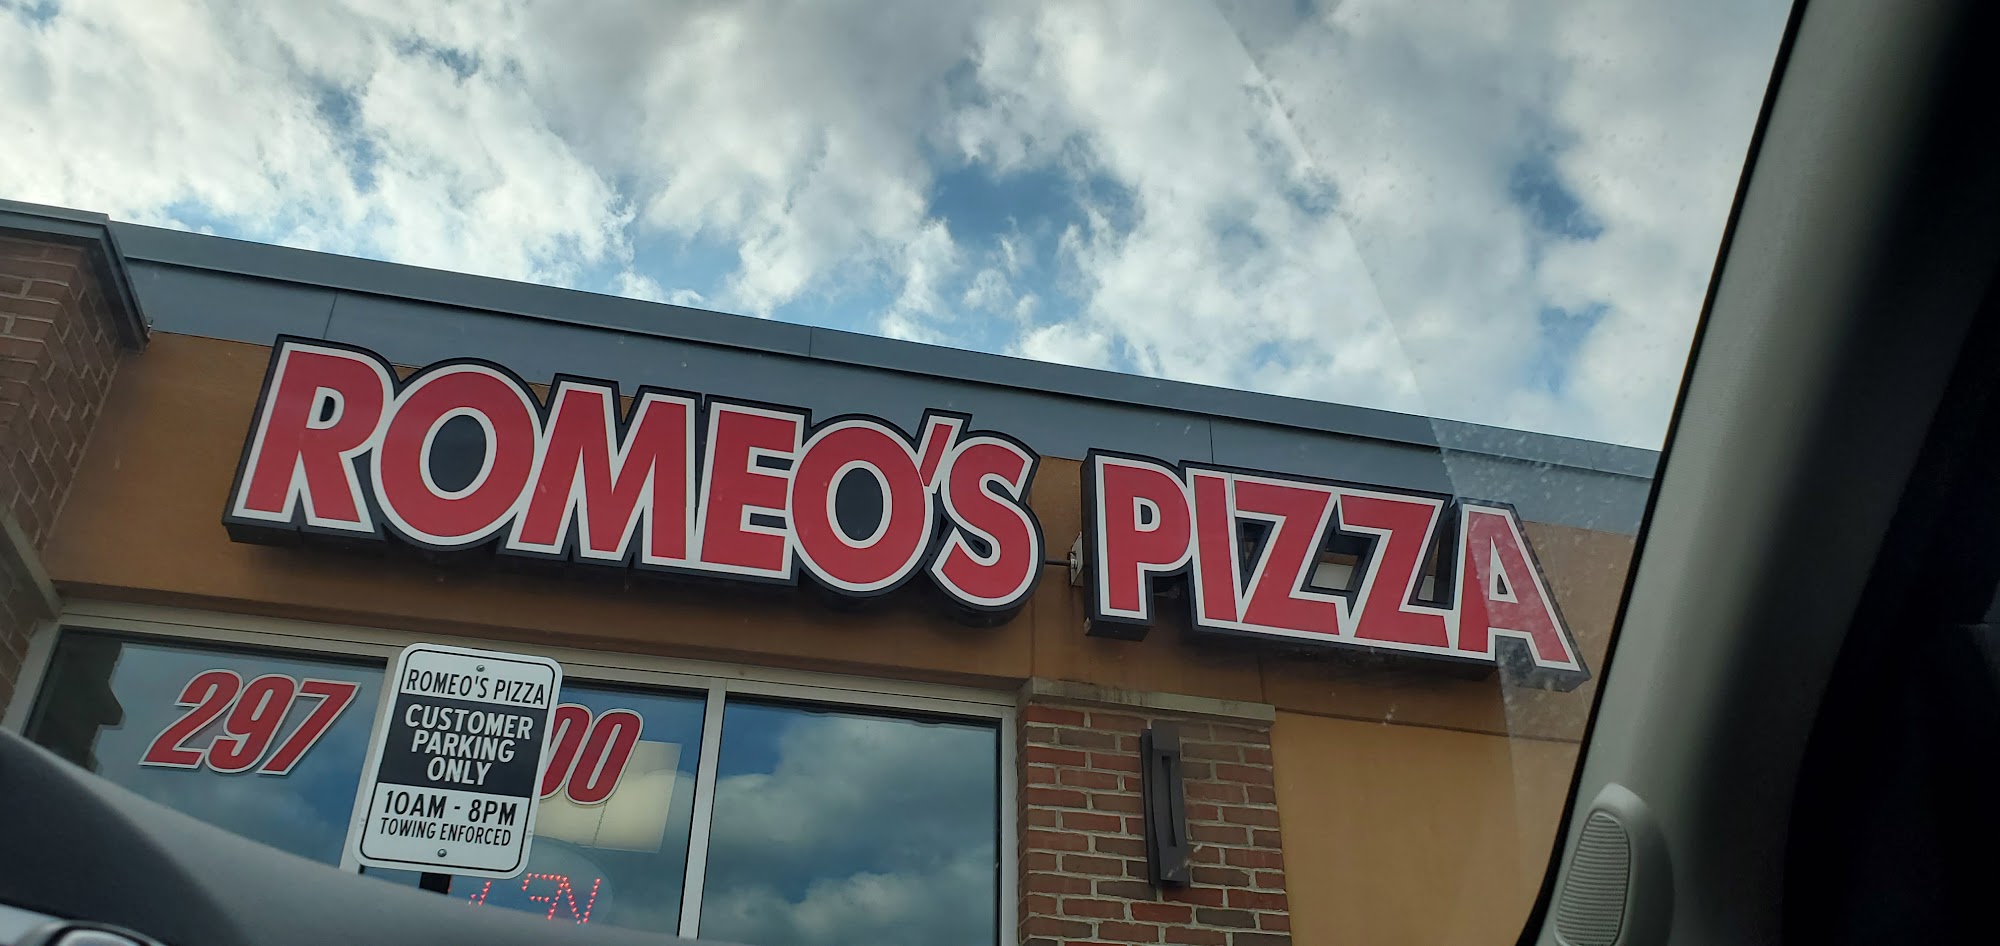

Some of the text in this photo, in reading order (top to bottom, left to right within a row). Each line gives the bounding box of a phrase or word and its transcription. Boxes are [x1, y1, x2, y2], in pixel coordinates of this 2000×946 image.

[231, 341, 1582, 673] ROMEO'S PIZZA
[406, 668, 545, 706] ROMEO'S PIZZA
[138, 668, 361, 776] 297
[404, 703, 534, 740] CUSTOMER
[410, 729, 516, 763] PARKING
[426, 756, 493, 786] ONLY
[384, 790, 448, 819] 10AM
[468, 798, 518, 826] 8PM
[379, 816, 511, 847] TOWING ENFORCED
